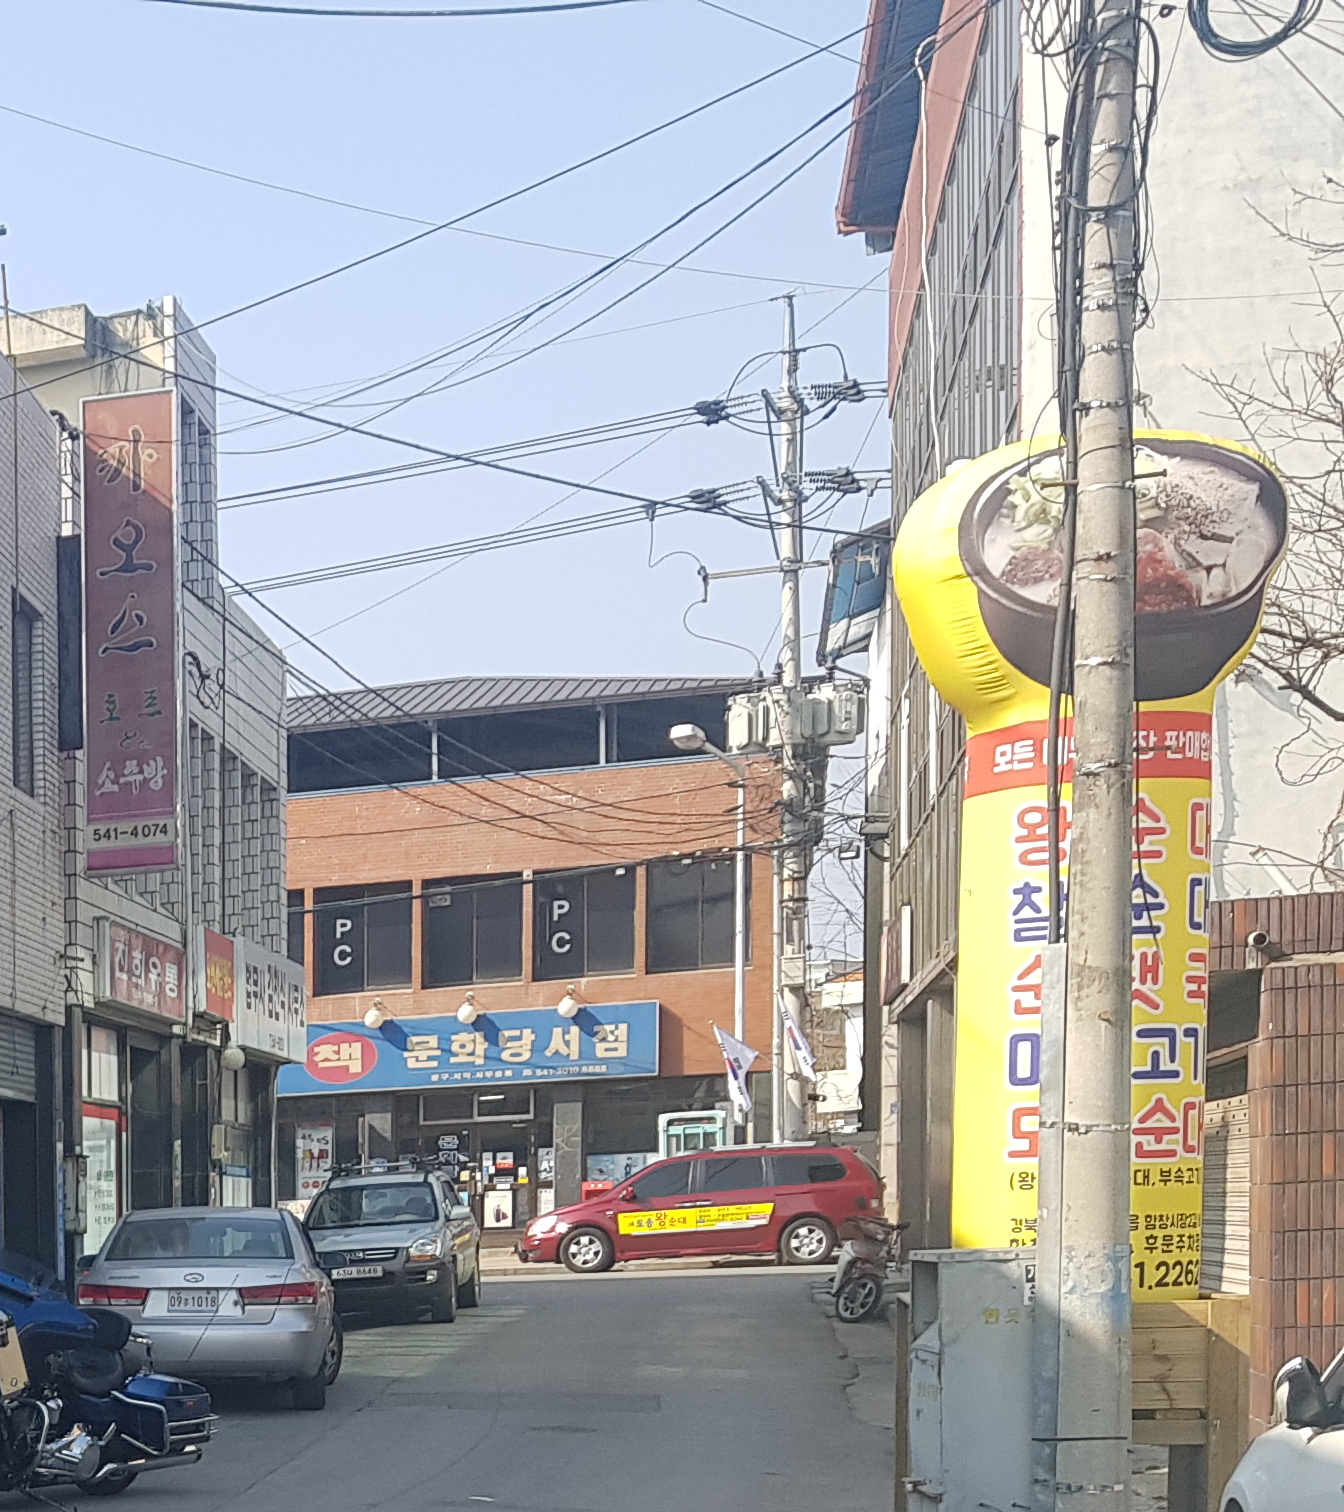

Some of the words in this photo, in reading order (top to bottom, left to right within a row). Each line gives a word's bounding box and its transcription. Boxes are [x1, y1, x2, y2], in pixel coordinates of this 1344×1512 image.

[992, 739, 1036, 774] 모든
[95, 756, 168, 796] 소주방
[93, 823, 169, 842] 541-4074
[312, 1041, 364, 1074] 책
[402, 1021, 630, 1070] 문화당서점
